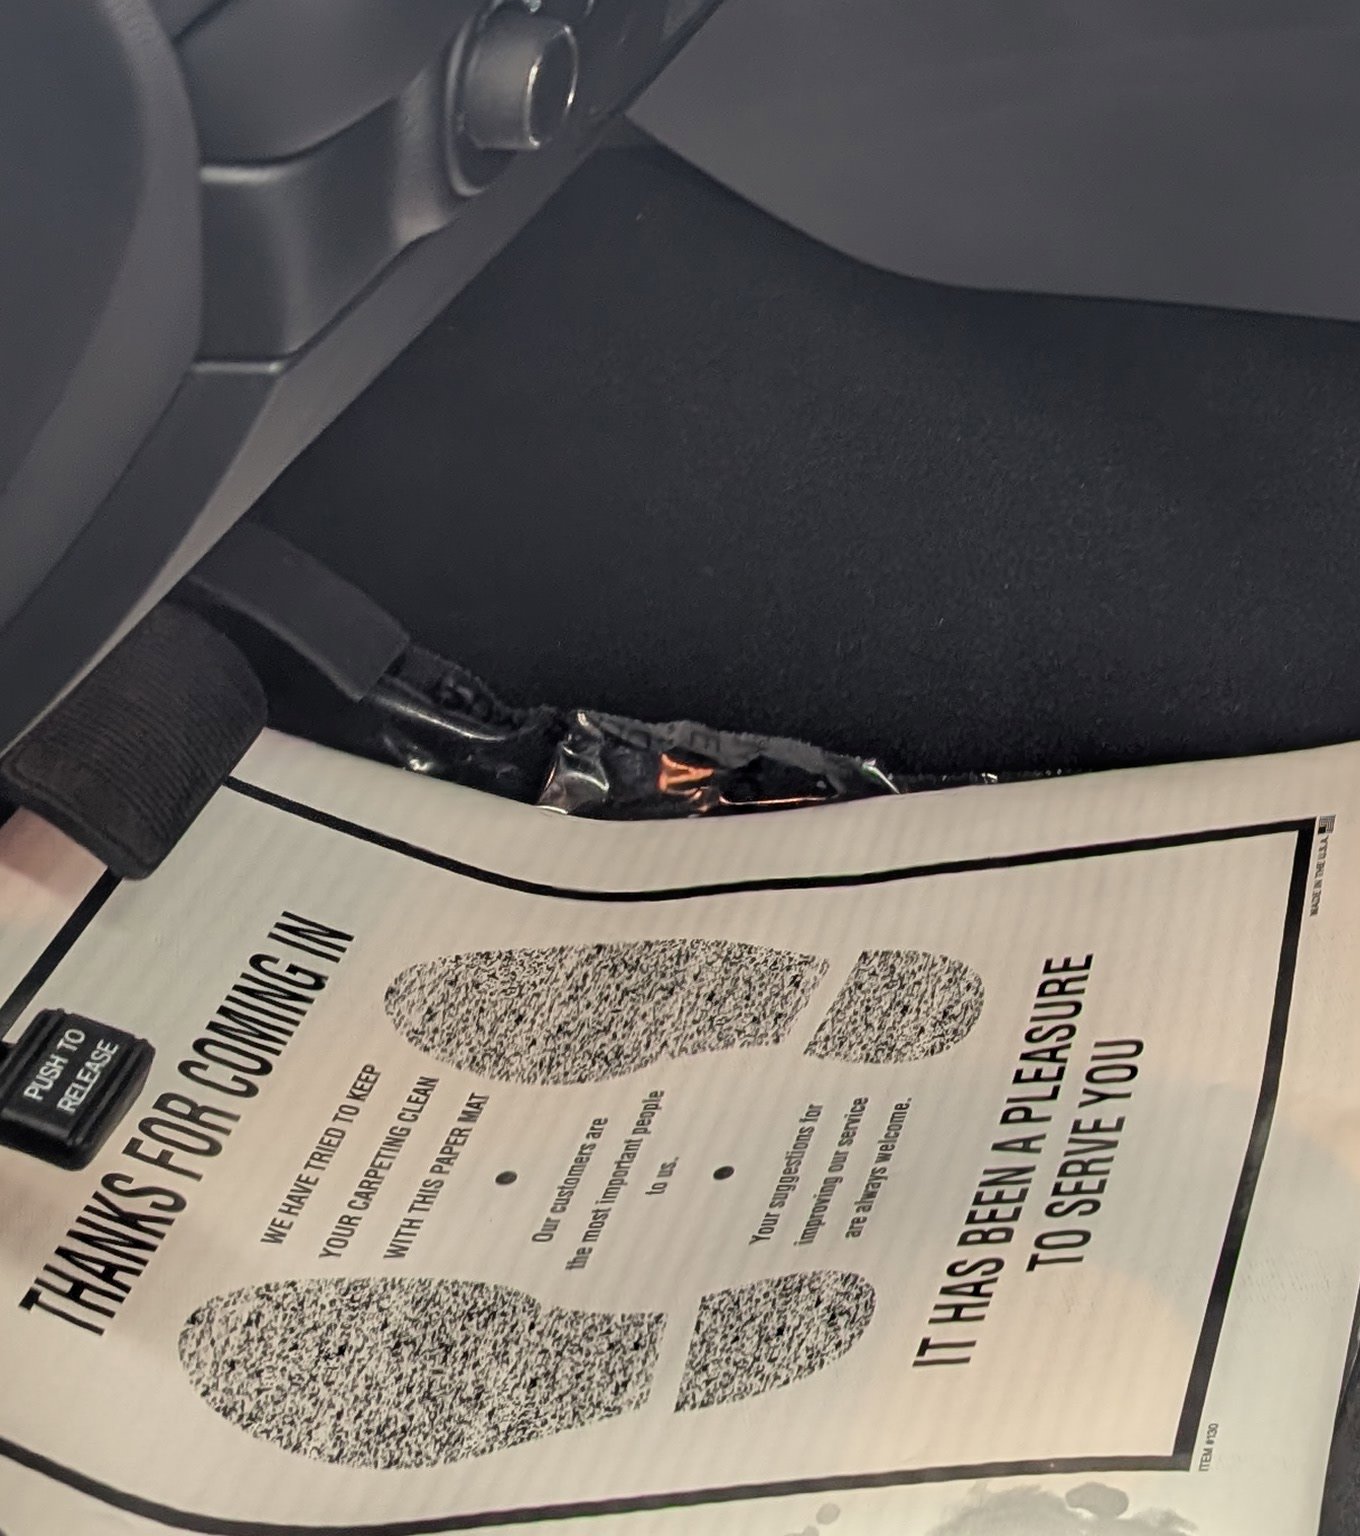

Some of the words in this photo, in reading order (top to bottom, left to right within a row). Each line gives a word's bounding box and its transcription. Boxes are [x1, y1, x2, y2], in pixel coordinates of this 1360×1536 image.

[267, 911, 355, 963] IN
[178, 953, 330, 1099] COMING
[1000, 953, 1094, 1126] PLEASURE
[23, 1052, 68, 1102] PUSH
[57, 1028, 86, 1061] TO
[56, 1039, 119, 1115] RELEASE
[1078, 1038, 1144, 1109] YOU
[121, 1092, 241, 1182] FOR
[632, 1090, 664, 1135] people
[838, 1097, 869, 1146] service
[875, 1098, 912, 1164] welcome.
[991, 1133, 1046, 1154] A
[260, 1217, 293, 1244] WE
[278, 1174, 320, 1216] HAVE
[304, 1127, 346, 1171] TRIED
[332, 1104, 360, 1123] TO
[346, 1064, 381, 1102] KEEP
[318, 1214, 362, 1259] YOUR
[347, 1126, 412, 1211] CARPETING
[397, 1076, 439, 1123] CLEAN
[383, 1218, 424, 1259] WITH
[408, 1179, 444, 1214] THIS
[429, 1127, 473, 1174] PAPER
[457, 1092, 490, 1123] MAT
[531, 1218, 560, 1243] Our
[550, 1143, 596, 1213] customers
[586, 1117, 608, 1140] are
[595, 1138, 643, 1205] important
[645, 1182, 668, 1195] to
[657, 1157, 679, 1178] us.
[749, 1212, 780, 1245] Your
[769, 1126, 815, 1208] suggestions
[799, 1104, 823, 1123] for
[828, 1150, 849, 1173] our
[1044, 1117, 1126, 1217] SERVE
[793, 1176, 843, 1246] improving
[854, 1167, 888, 1213] always
[957, 1165, 1036, 1247] BEEN
[18, 1172, 187, 1337] THANKS
[565, 1247, 593, 1271] the
[582, 1208, 612, 1243] most
[845, 1217, 867, 1238] are
[1027, 1229, 1091, 1272] TO
[928, 1258, 1005, 1324] HAS
[912, 1337, 977, 1367] IT
[1198, 1448, 1213, 1472] ITEM
